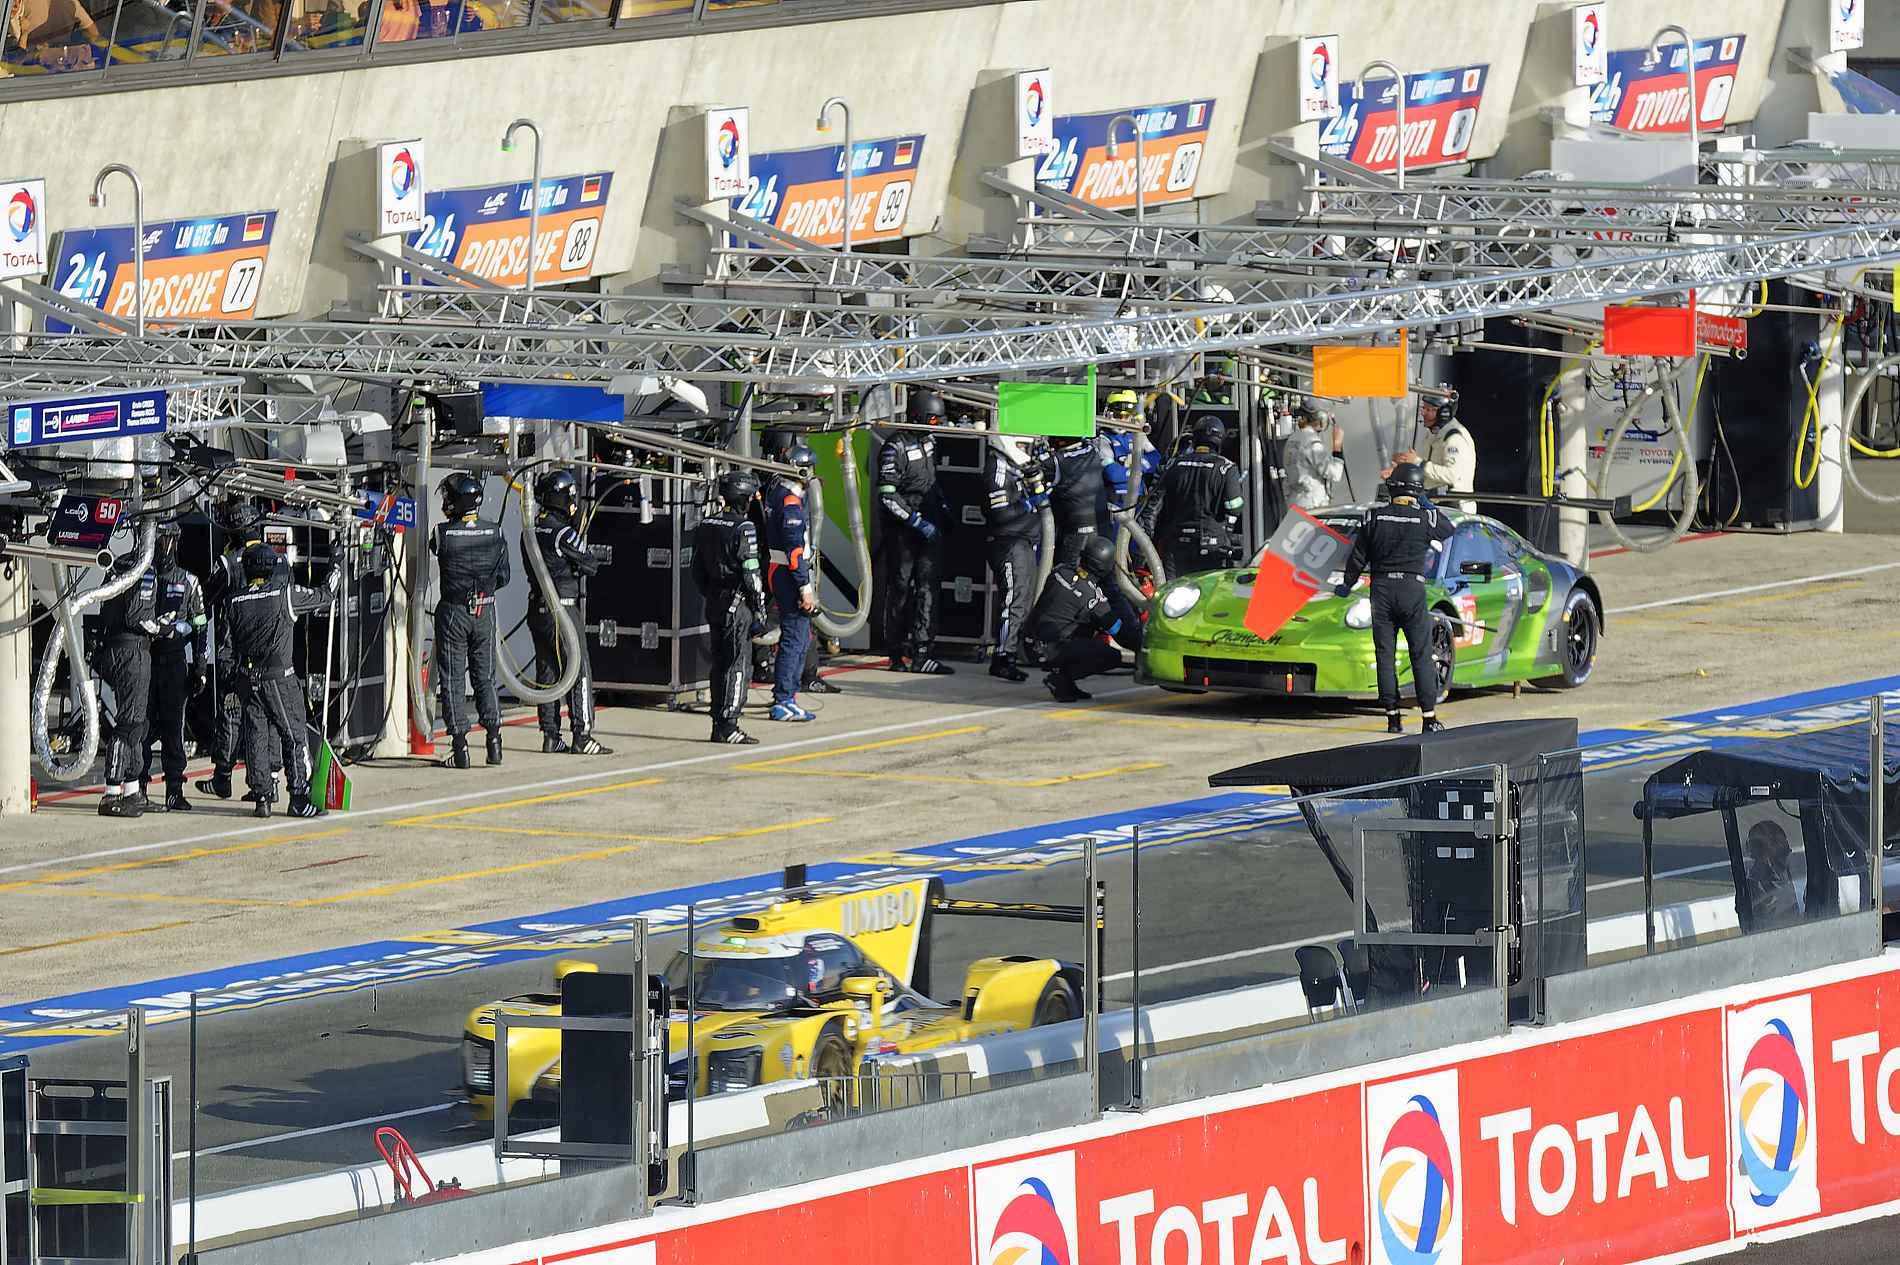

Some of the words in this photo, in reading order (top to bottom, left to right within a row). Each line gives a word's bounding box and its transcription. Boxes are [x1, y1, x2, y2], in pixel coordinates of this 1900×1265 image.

[1319, 102, 1359, 144] 24h
[1628, 85, 1692, 131] TOYOTA
[1037, 136, 1079, 180] 24h
[385, 210, 421, 225] TOTAL
[737, 175, 778, 218] 24h
[881, 187, 905, 223] 99
[175, 225, 195, 249] LM
[192, 223, 216, 247] GTE
[211, 222, 230, 245] Am
[414, 213, 456, 258] 24h
[460, 228, 564, 278] PORSCHE
[568, 226, 592, 262] 88
[2, 251, 43, 267] TOTAL
[60, 250, 107, 299] 24h
[112, 268, 224, 319] PORSCHE
[229, 266, 257, 303] 77
[16, 418, 31, 434] 50
[100, 501, 117, 520] 50
[396, 501, 413, 522] 36
[1281, 521, 1338, 570] 99
[1480, 1096, 1710, 1226] TOTAL
[1099, 1176, 1347, 1265] TOTAL
